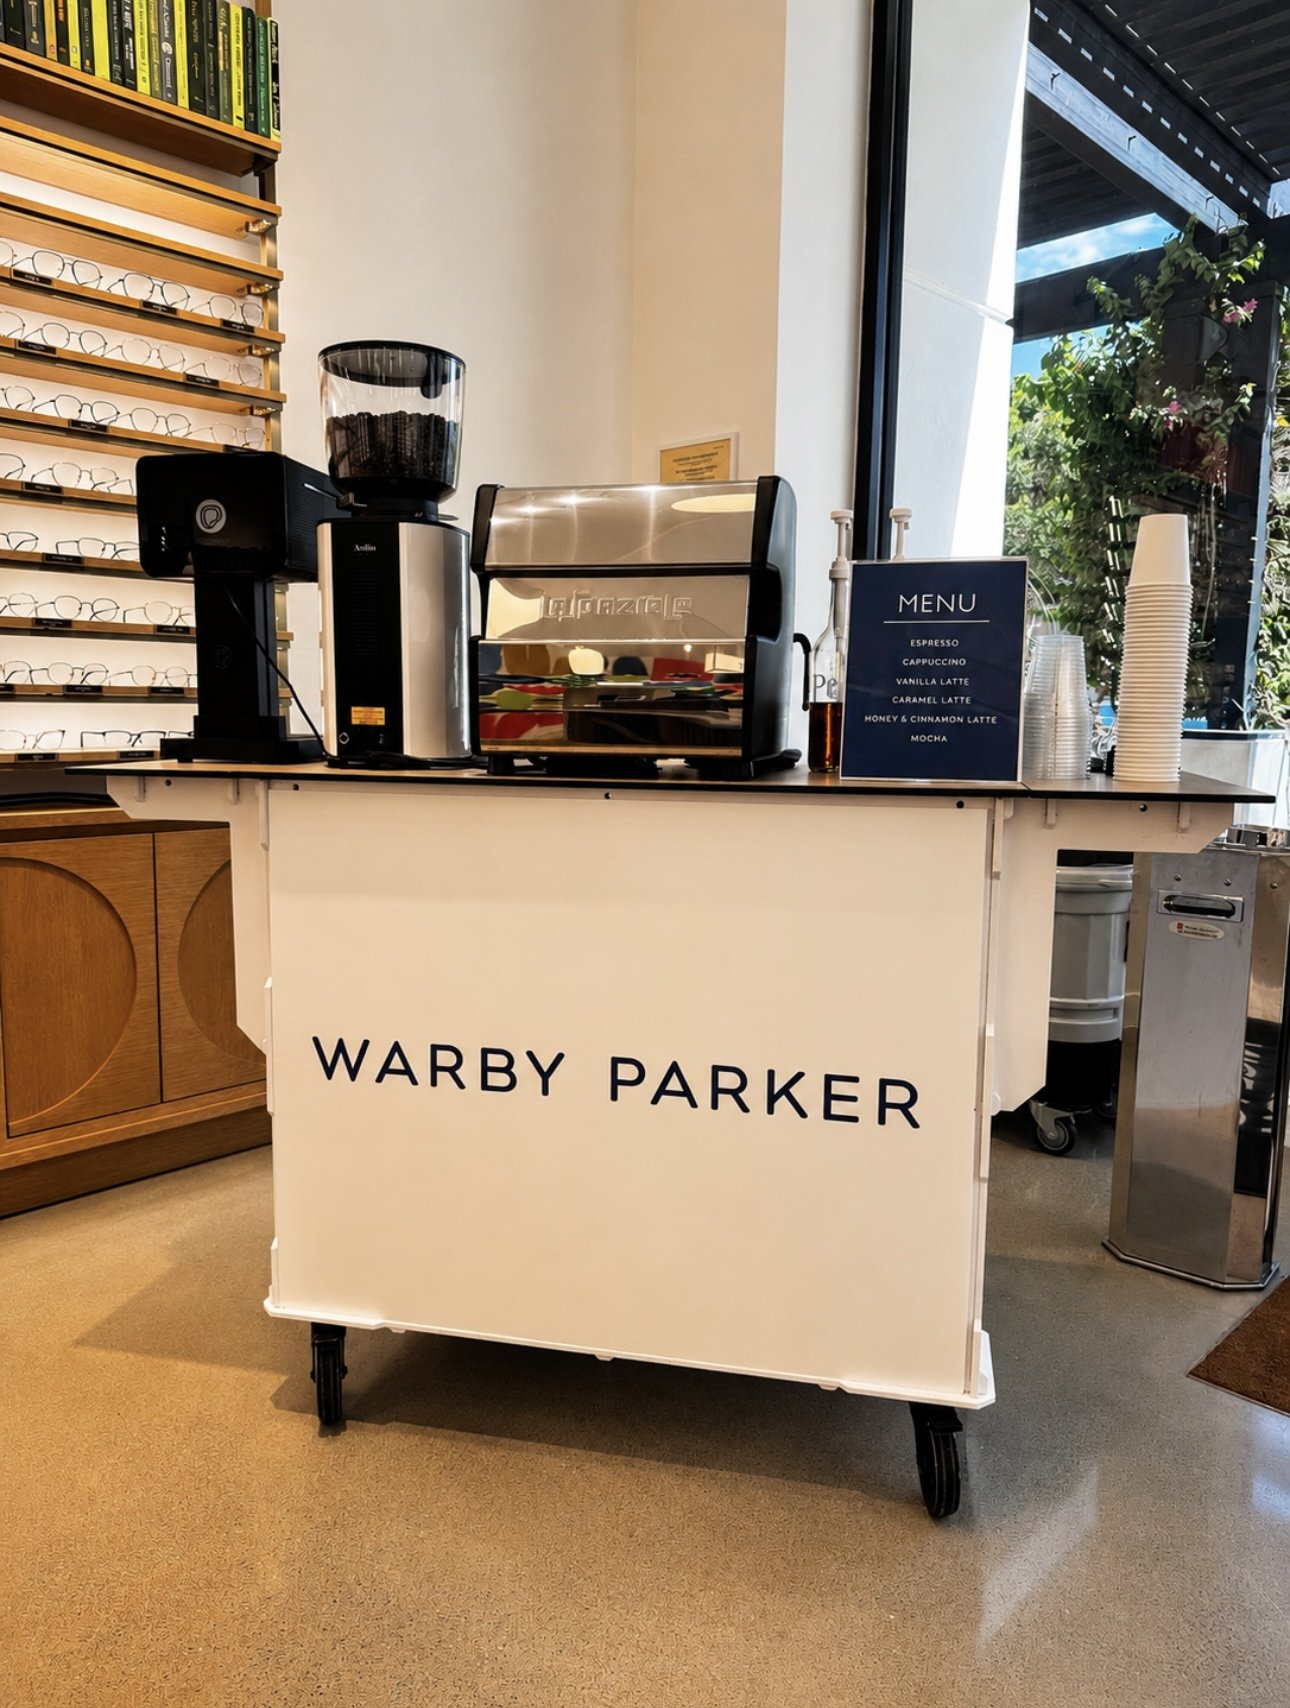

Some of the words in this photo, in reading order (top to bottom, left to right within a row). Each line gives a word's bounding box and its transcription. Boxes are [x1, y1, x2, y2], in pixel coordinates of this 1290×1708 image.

[898, 593, 976, 613] MENU
[910, 639, 959, 648] ESPRESSO
[902, 658, 967, 666] CAPPUCCINO
[896, 677, 937, 686] VANILLA
[940, 677, 970, 686] LATTE
[892, 696, 937, 705] CARAMEL
[941, 696, 971, 705] LATTE
[864, 714, 898, 724] HONEY
[900, 715, 908, 723] &
[910, 715, 964, 724] CINNAMON
[967, 716, 998, 725] LATTE
[910, 734, 948, 743] MOCHA
[311, 1035, 565, 1097] WARBY
[610, 1056, 921, 1130] PARKER
